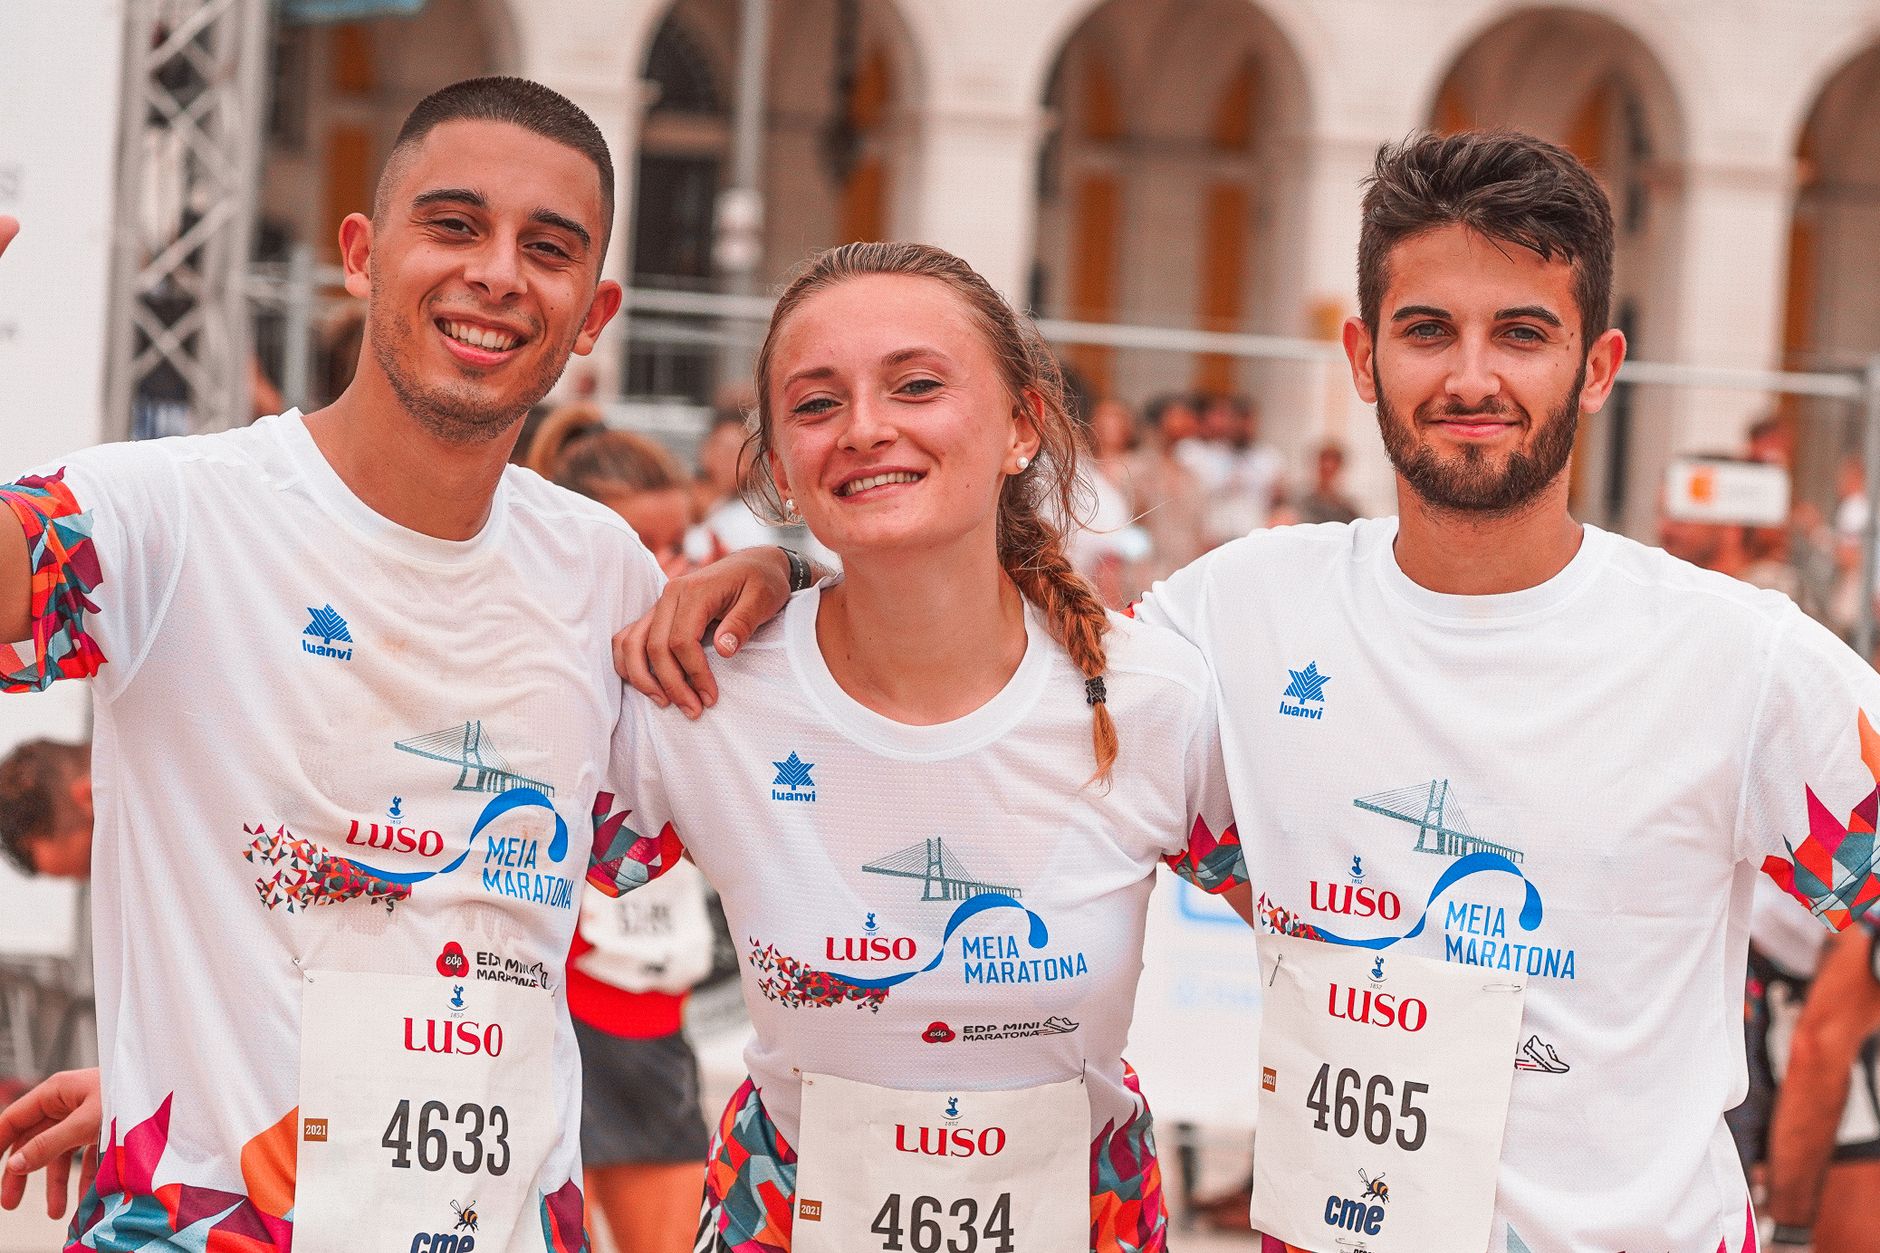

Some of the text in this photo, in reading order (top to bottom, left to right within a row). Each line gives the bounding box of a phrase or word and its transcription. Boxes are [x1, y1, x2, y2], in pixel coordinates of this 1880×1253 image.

[301, 639, 353, 661] luanvi
[1279, 701, 1323, 720] luanvi
[771, 789, 816, 802] luanvi
[345, 819, 444, 857] LUSO
[484, 835, 538, 870] MEIA
[482, 867, 574, 910] MARATONA
[1309, 880, 1401, 921] LUSO
[1444, 900, 1505, 938] MEIA
[445, 953, 463, 969] edp
[825, 936, 917, 962] LUSO
[961, 935, 1020, 960] MEIA
[1445, 933, 1575, 980] MARATONA
[964, 952, 1088, 984] MARATONA
[1328, 982, 1428, 1033] LUSO
[403, 1016, 504, 1058] LUSO
[962, 1029, 1041, 1042] MARATONA
[963, 1021, 1041, 1034] EDP MINI
[1306, 1062, 1430, 1152] 4665
[304, 1123, 327, 1137] 2021
[381, 1098, 511, 1177] 4633
[895, 1123, 1007, 1158] LUSO
[800, 1203, 821, 1217] 2021
[870, 1192, 1015, 1253] 4634
[1324, 1195, 1385, 1236] cme
